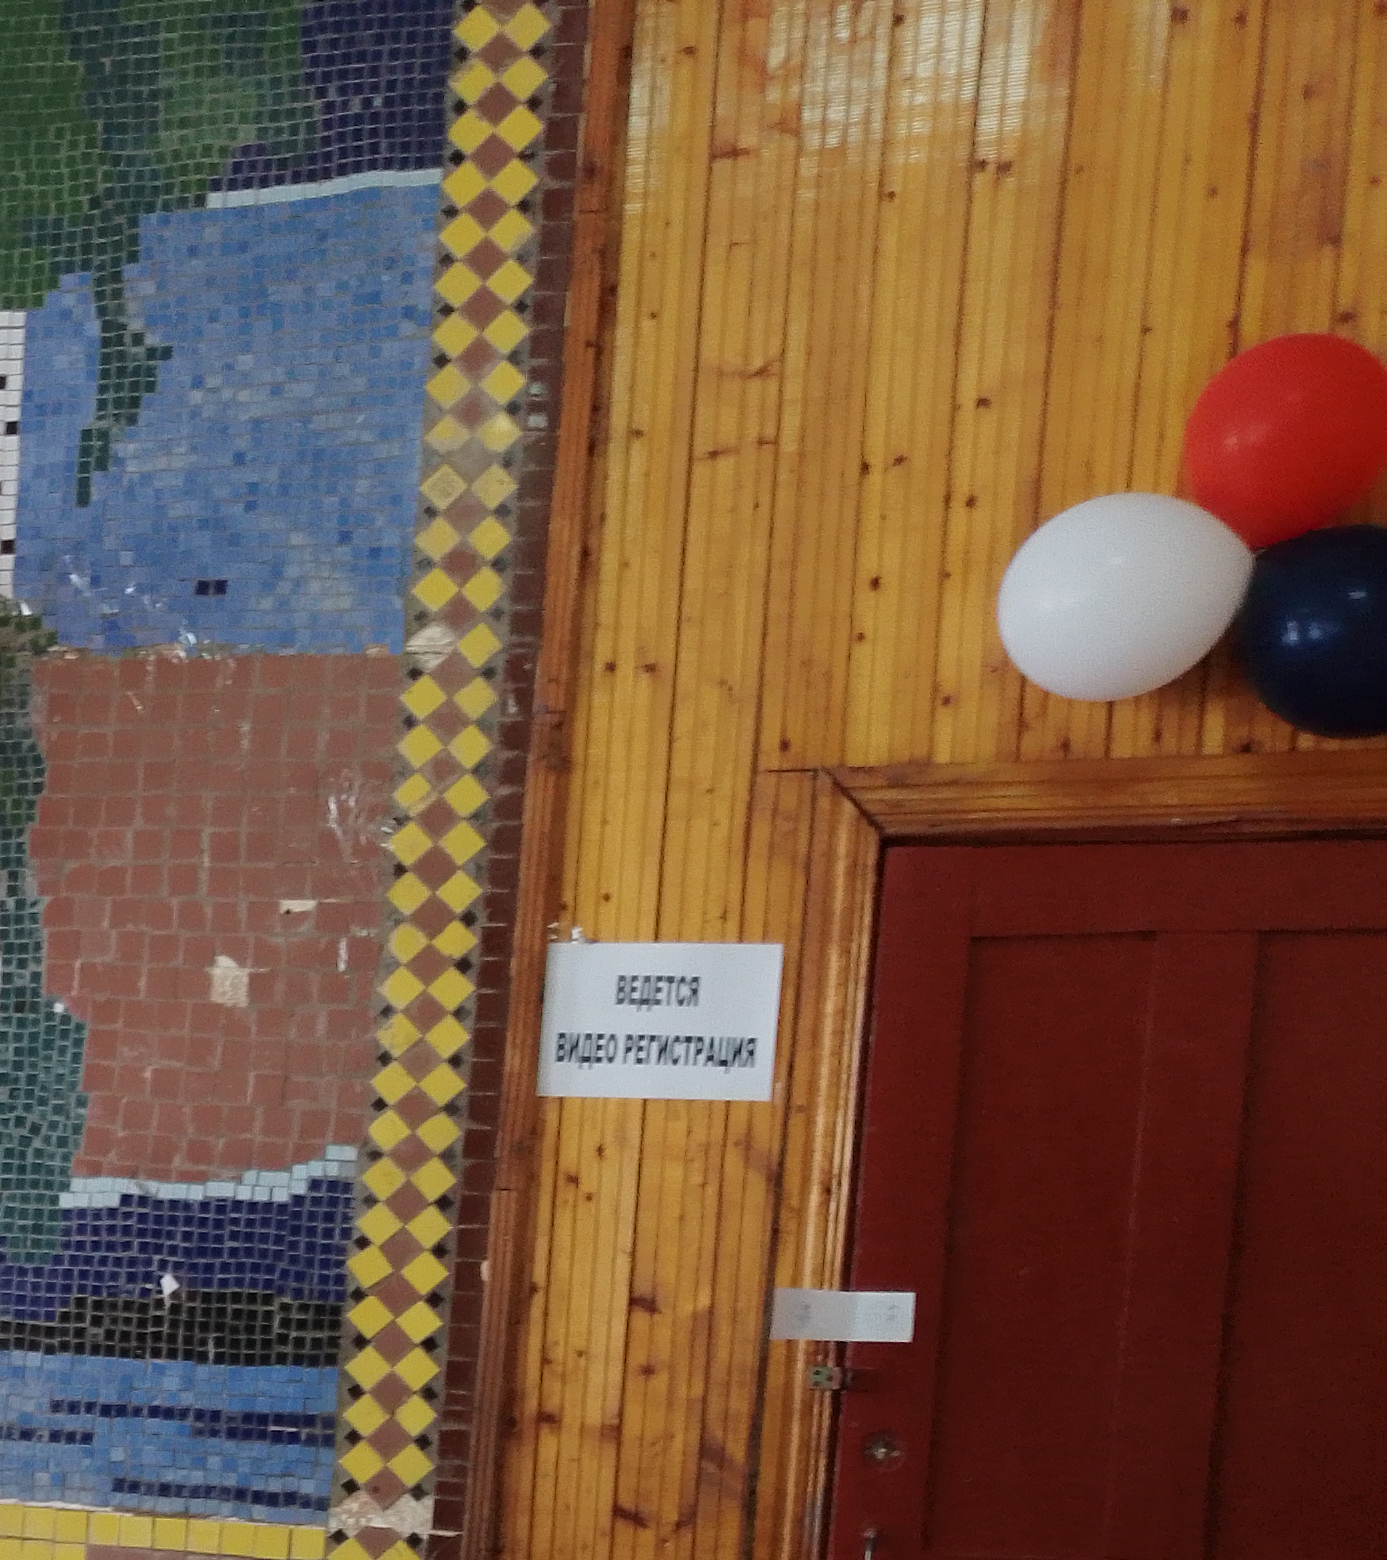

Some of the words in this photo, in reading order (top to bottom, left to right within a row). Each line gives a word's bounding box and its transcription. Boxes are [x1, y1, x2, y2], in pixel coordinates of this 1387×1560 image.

[615, 975, 701, 1012] ВЕДЕТСЯ
[555, 1032, 618, 1069] ВИДЕО
[623, 1034, 758, 1074] РЕГИСТРАЦИЯ
